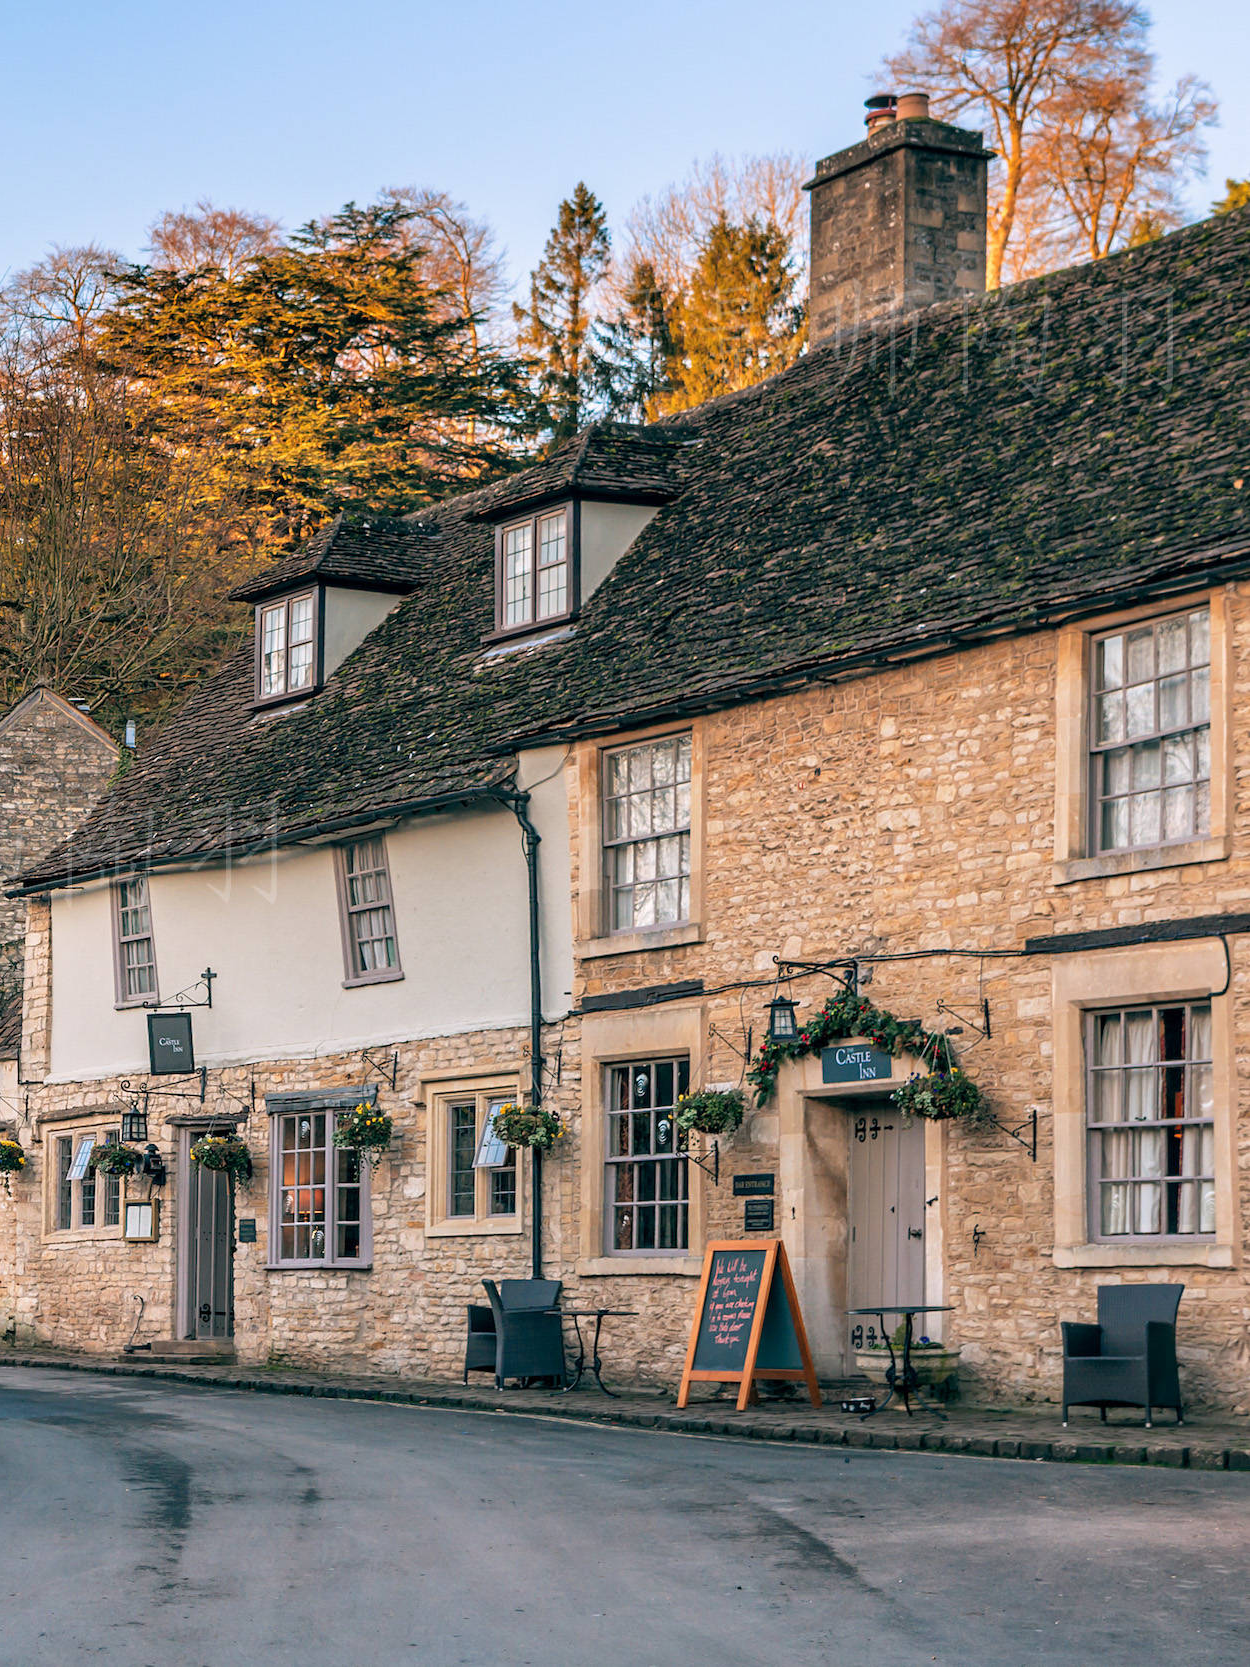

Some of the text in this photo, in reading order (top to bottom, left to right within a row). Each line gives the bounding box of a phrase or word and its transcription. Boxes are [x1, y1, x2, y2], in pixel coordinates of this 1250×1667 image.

[173, 1045, 183, 1053] INN
[835, 1048, 871, 1065] CASTLE
[859, 1063, 877, 1080] INN
